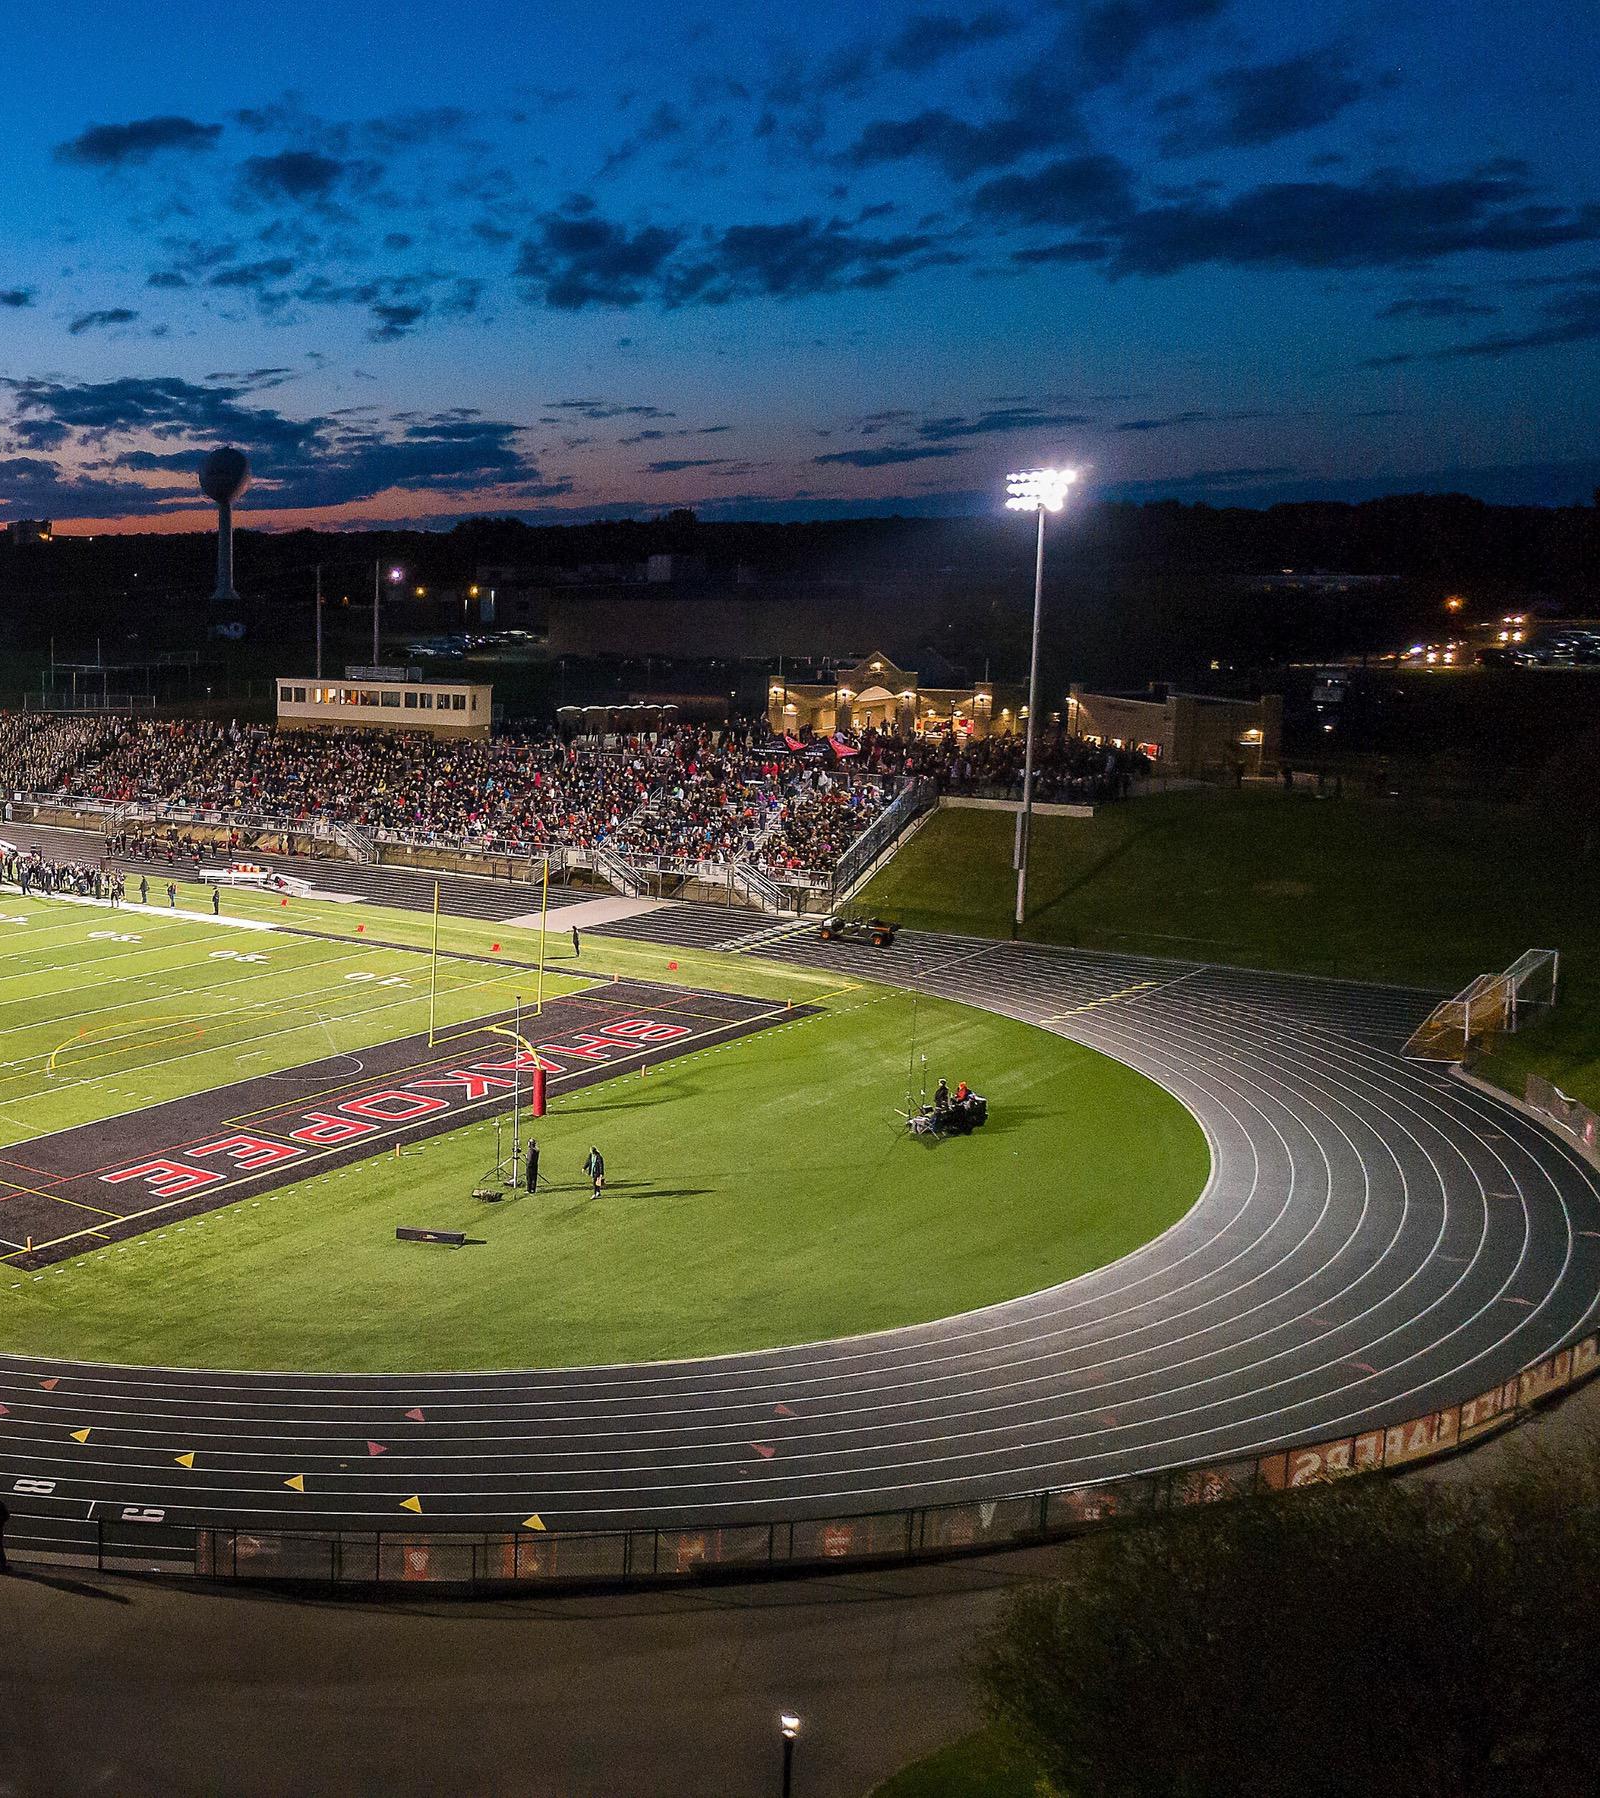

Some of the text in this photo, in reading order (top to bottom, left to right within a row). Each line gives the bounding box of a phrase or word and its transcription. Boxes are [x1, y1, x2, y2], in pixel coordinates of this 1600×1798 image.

[98, 1019, 693, 1198] SHAKOPEE
[12, 1479, 57, 1494] 8
[121, 1507, 166, 1523] 9
